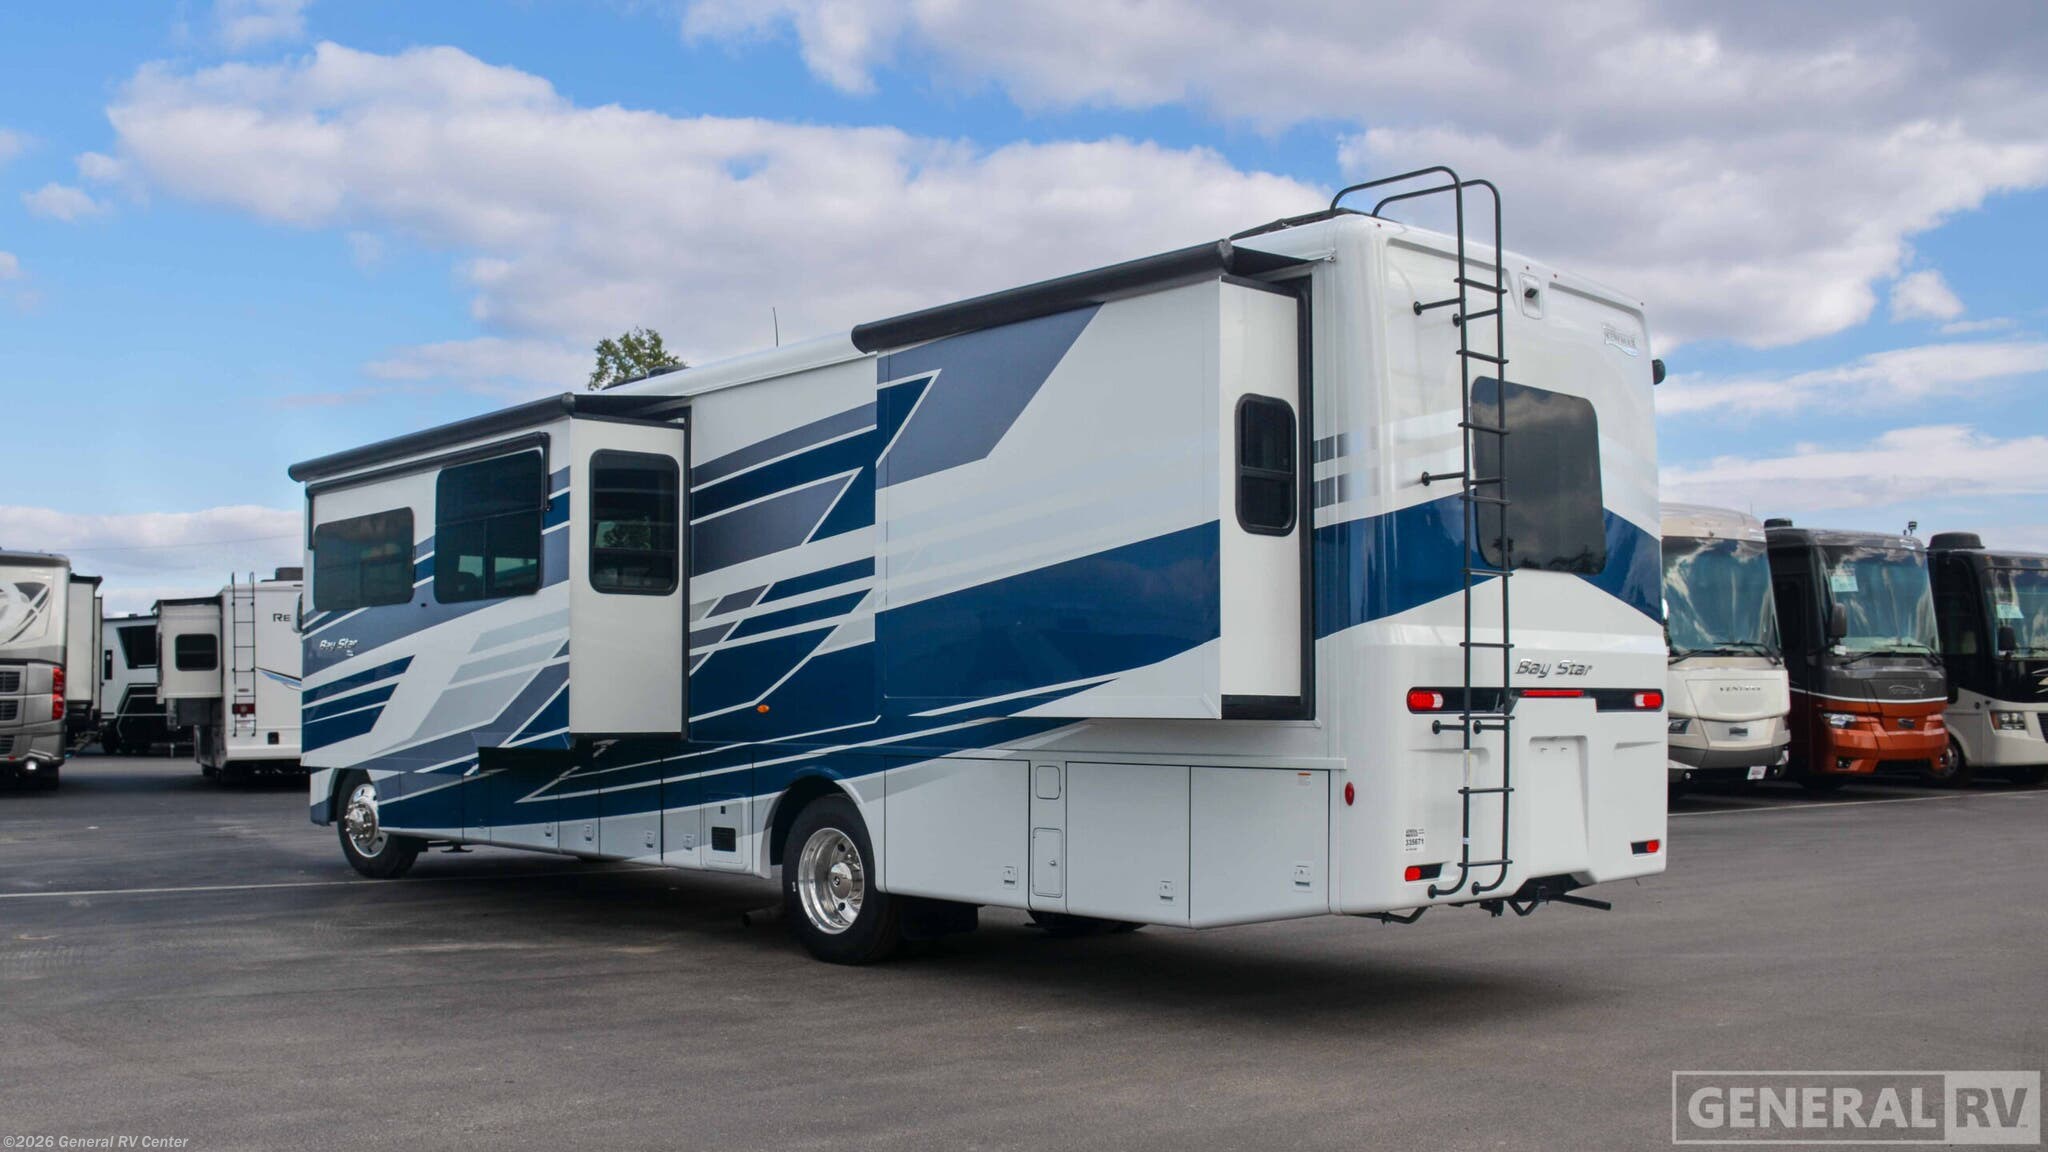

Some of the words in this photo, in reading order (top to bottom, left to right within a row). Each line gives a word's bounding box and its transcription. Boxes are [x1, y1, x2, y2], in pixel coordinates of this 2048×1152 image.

[320, 640, 338, 651] Bay
[338, 638, 358, 649] Star
[1516, 659, 1551, 678] Bay
[1556, 660, 1592, 676] Star
